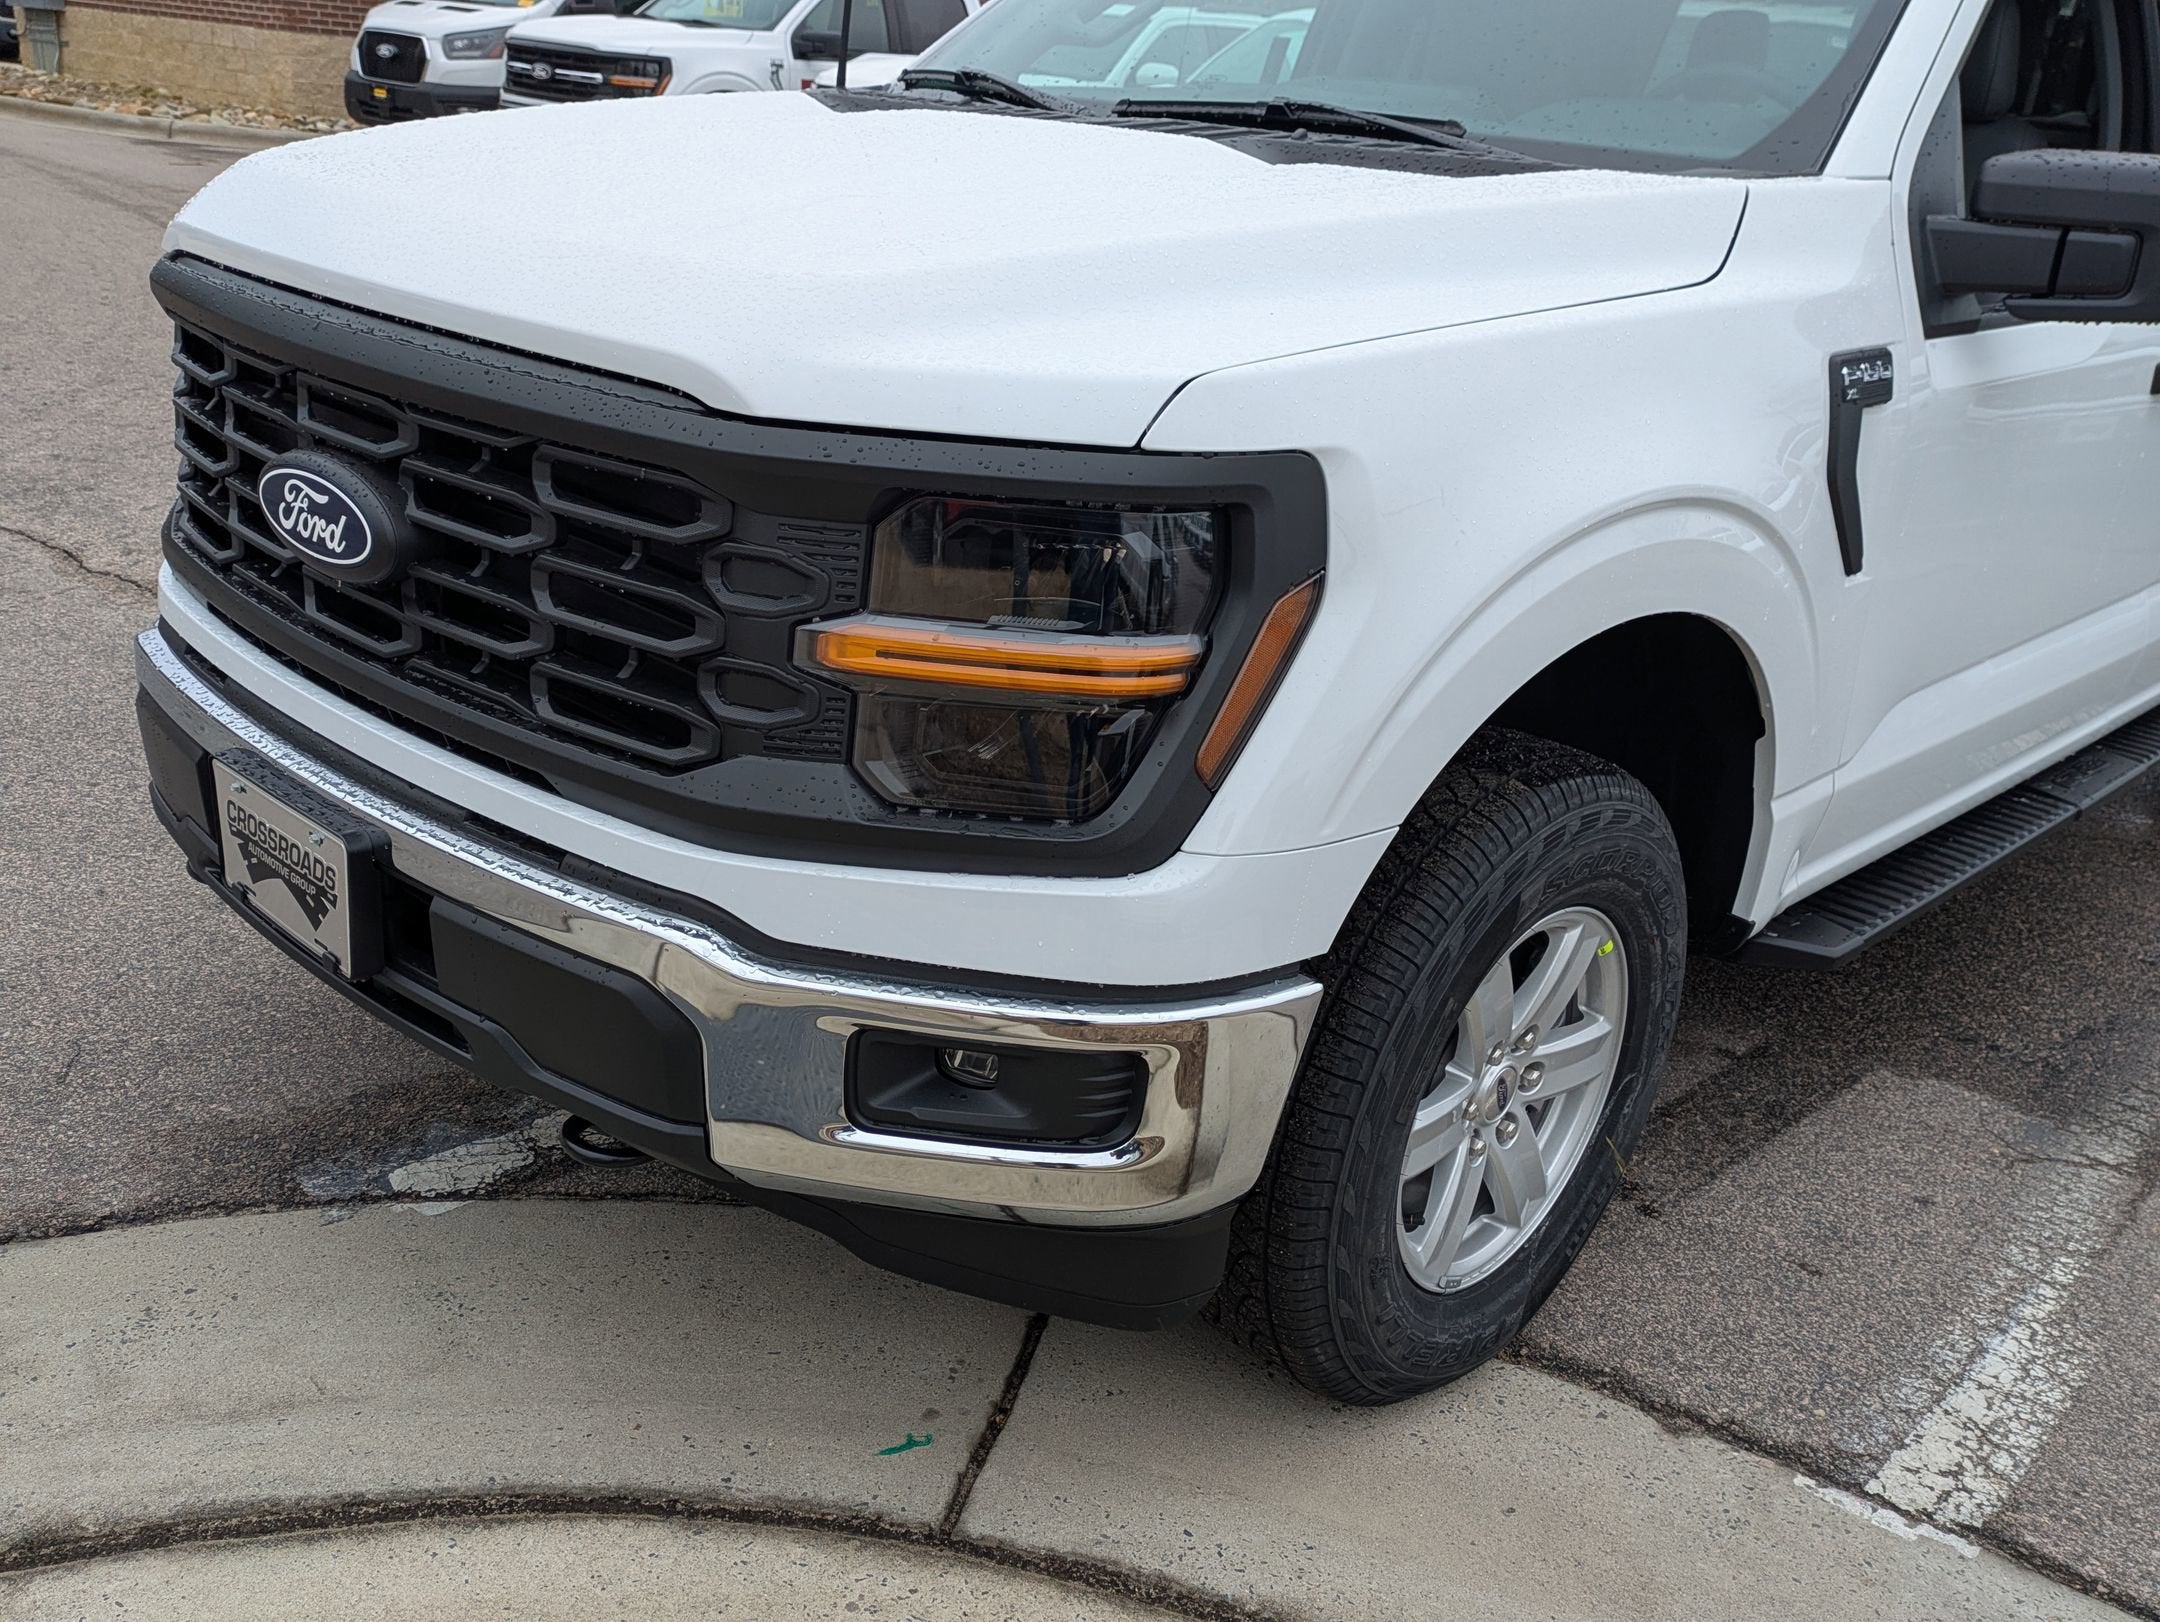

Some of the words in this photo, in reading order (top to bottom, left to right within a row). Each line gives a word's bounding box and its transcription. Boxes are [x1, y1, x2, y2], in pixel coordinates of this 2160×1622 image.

[279, 479, 346, 553] Ford
[227, 799, 337, 893] CROSSROADS
[247, 841, 290, 880] AUTOMOTIVE
[290, 870, 316, 896] GROUP
[1377, 1303, 1498, 1366] PIRELLI
